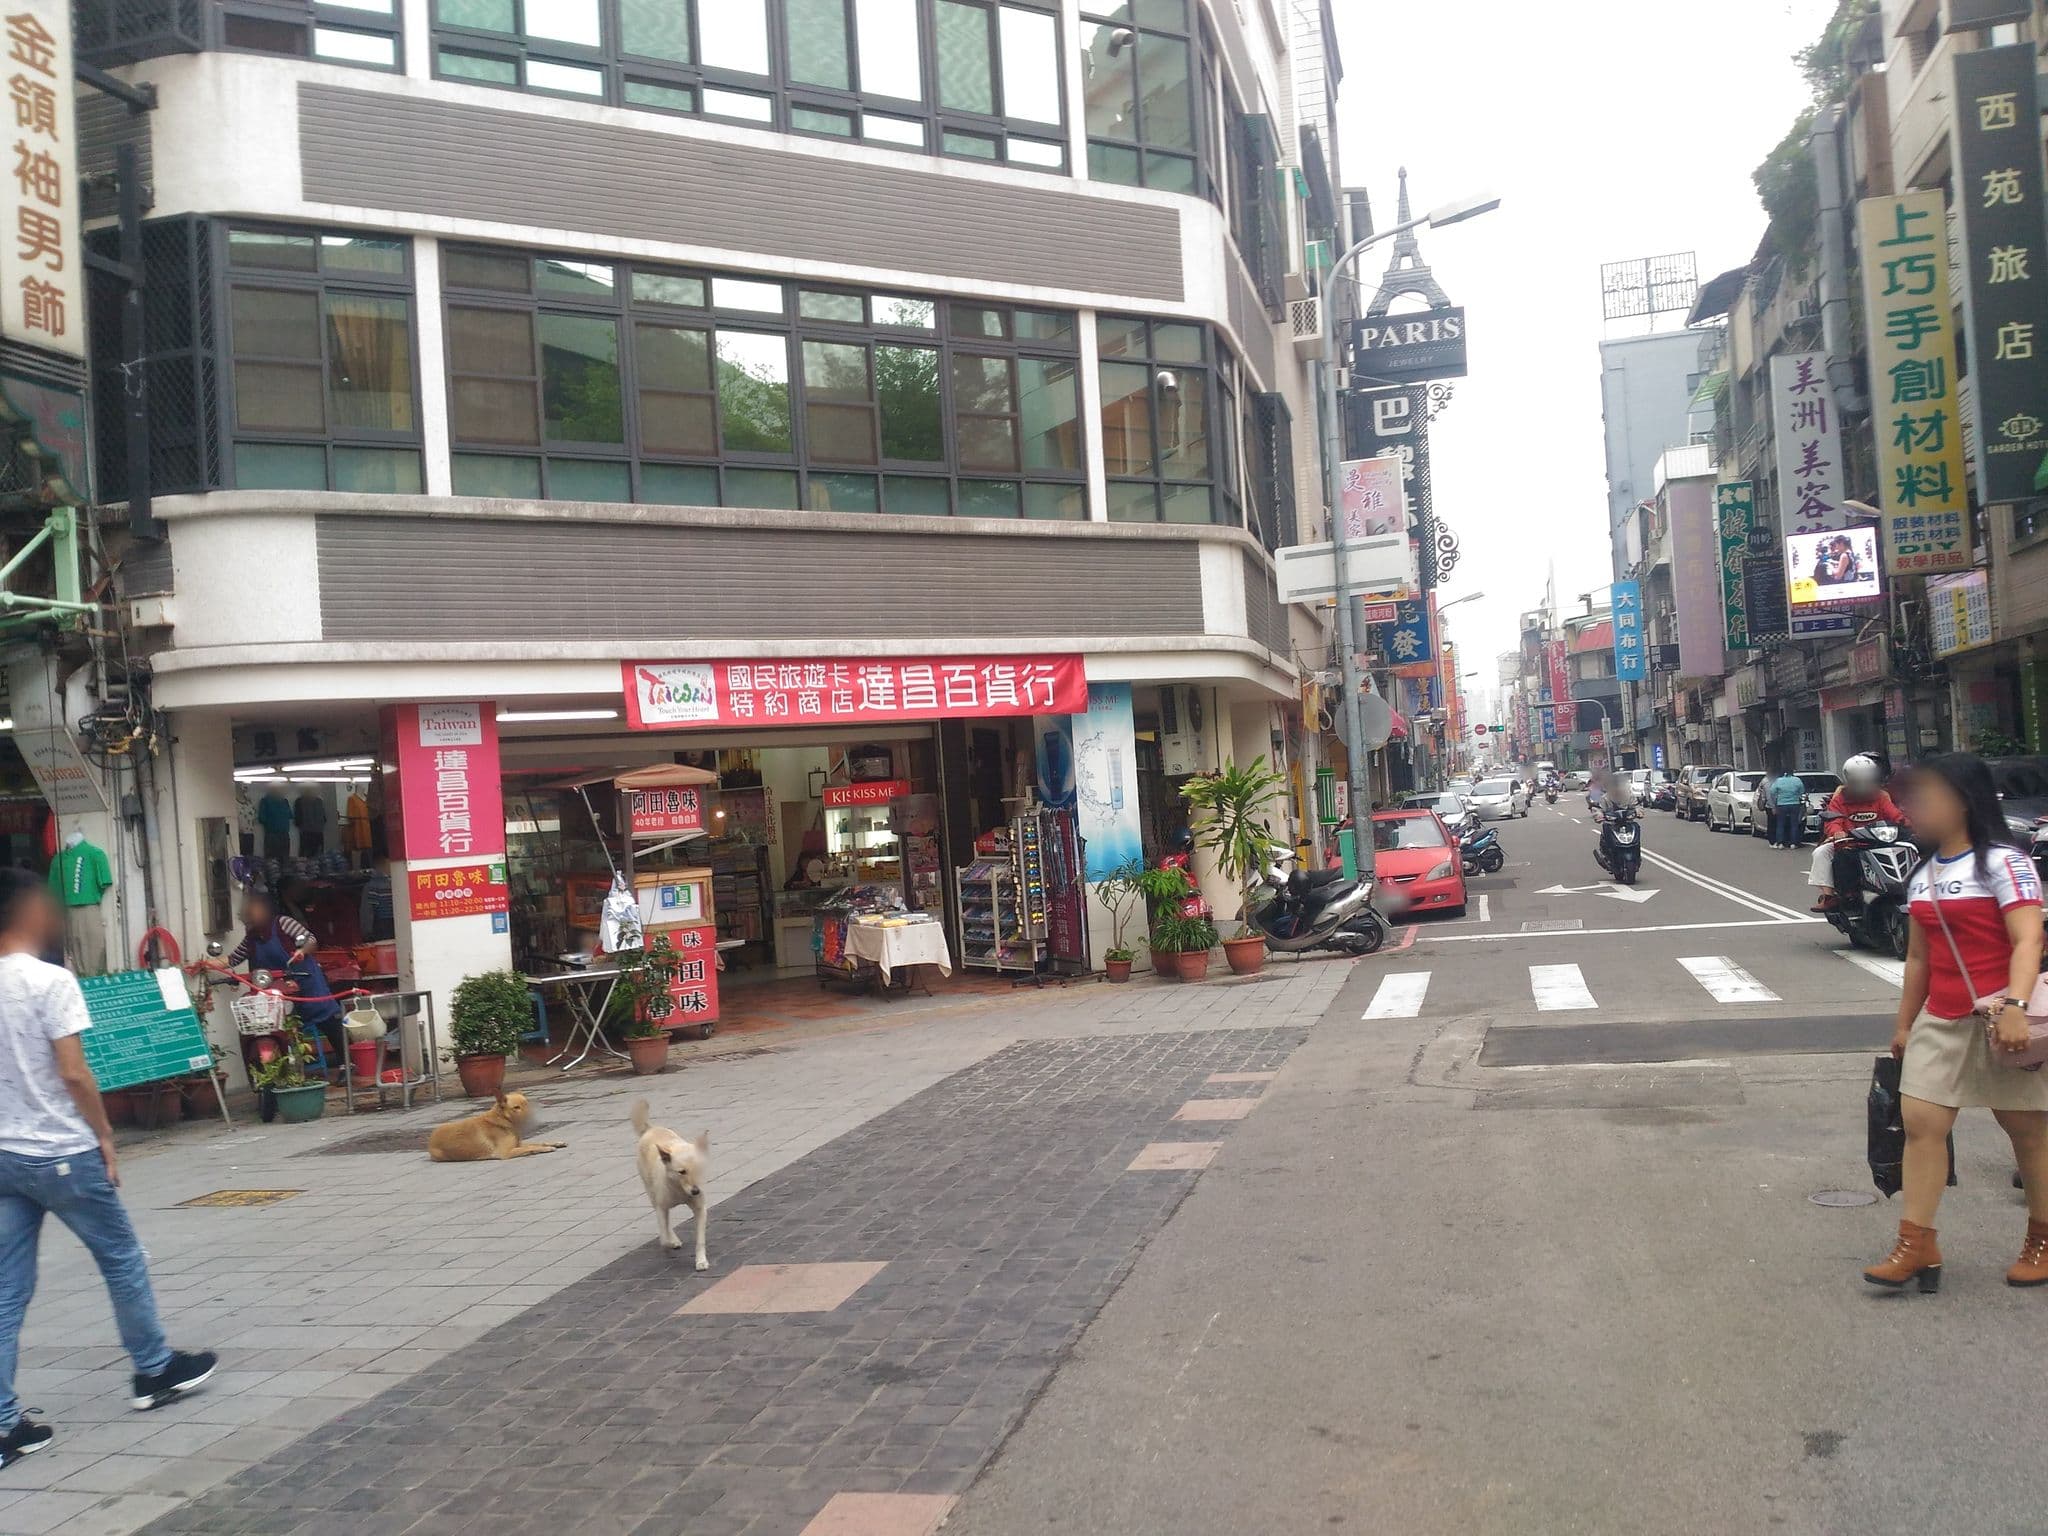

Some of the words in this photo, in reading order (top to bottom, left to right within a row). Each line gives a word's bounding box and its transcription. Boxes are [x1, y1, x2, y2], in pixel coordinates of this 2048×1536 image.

[5, 12, 66, 338] 金領袖男飾
[1976, 92, 2034, 361] 西苑旅店
[1360, 317, 1462, 350] PARIS
[1388, 356, 1433, 367] JEWELRY
[1878, 203, 1953, 508] 上巧手創材料
[1893, 512, 1959, 529] 服裝材料
[1894, 527, 1961, 544] 拼布材料
[1898, 541, 1957, 555] DIY
[1896, 552, 1964, 569] 教學用品
[1617, 591, 1639, 670] 大同布行
[728, 664, 850, 690] 國民旅遊卡
[857, 663, 1056, 710] 達昌百貨行
[729, 688, 854, 717] 特約商店
[423, 718, 477, 731] Taiwan
[433, 750, 473, 853] 達昌百貨行
[632, 789, 698, 816] 阿田魯味
[853, 789, 876, 799] KISS
[878, 788, 894, 798] ME
[417, 868, 484, 889] 阿田魯味
